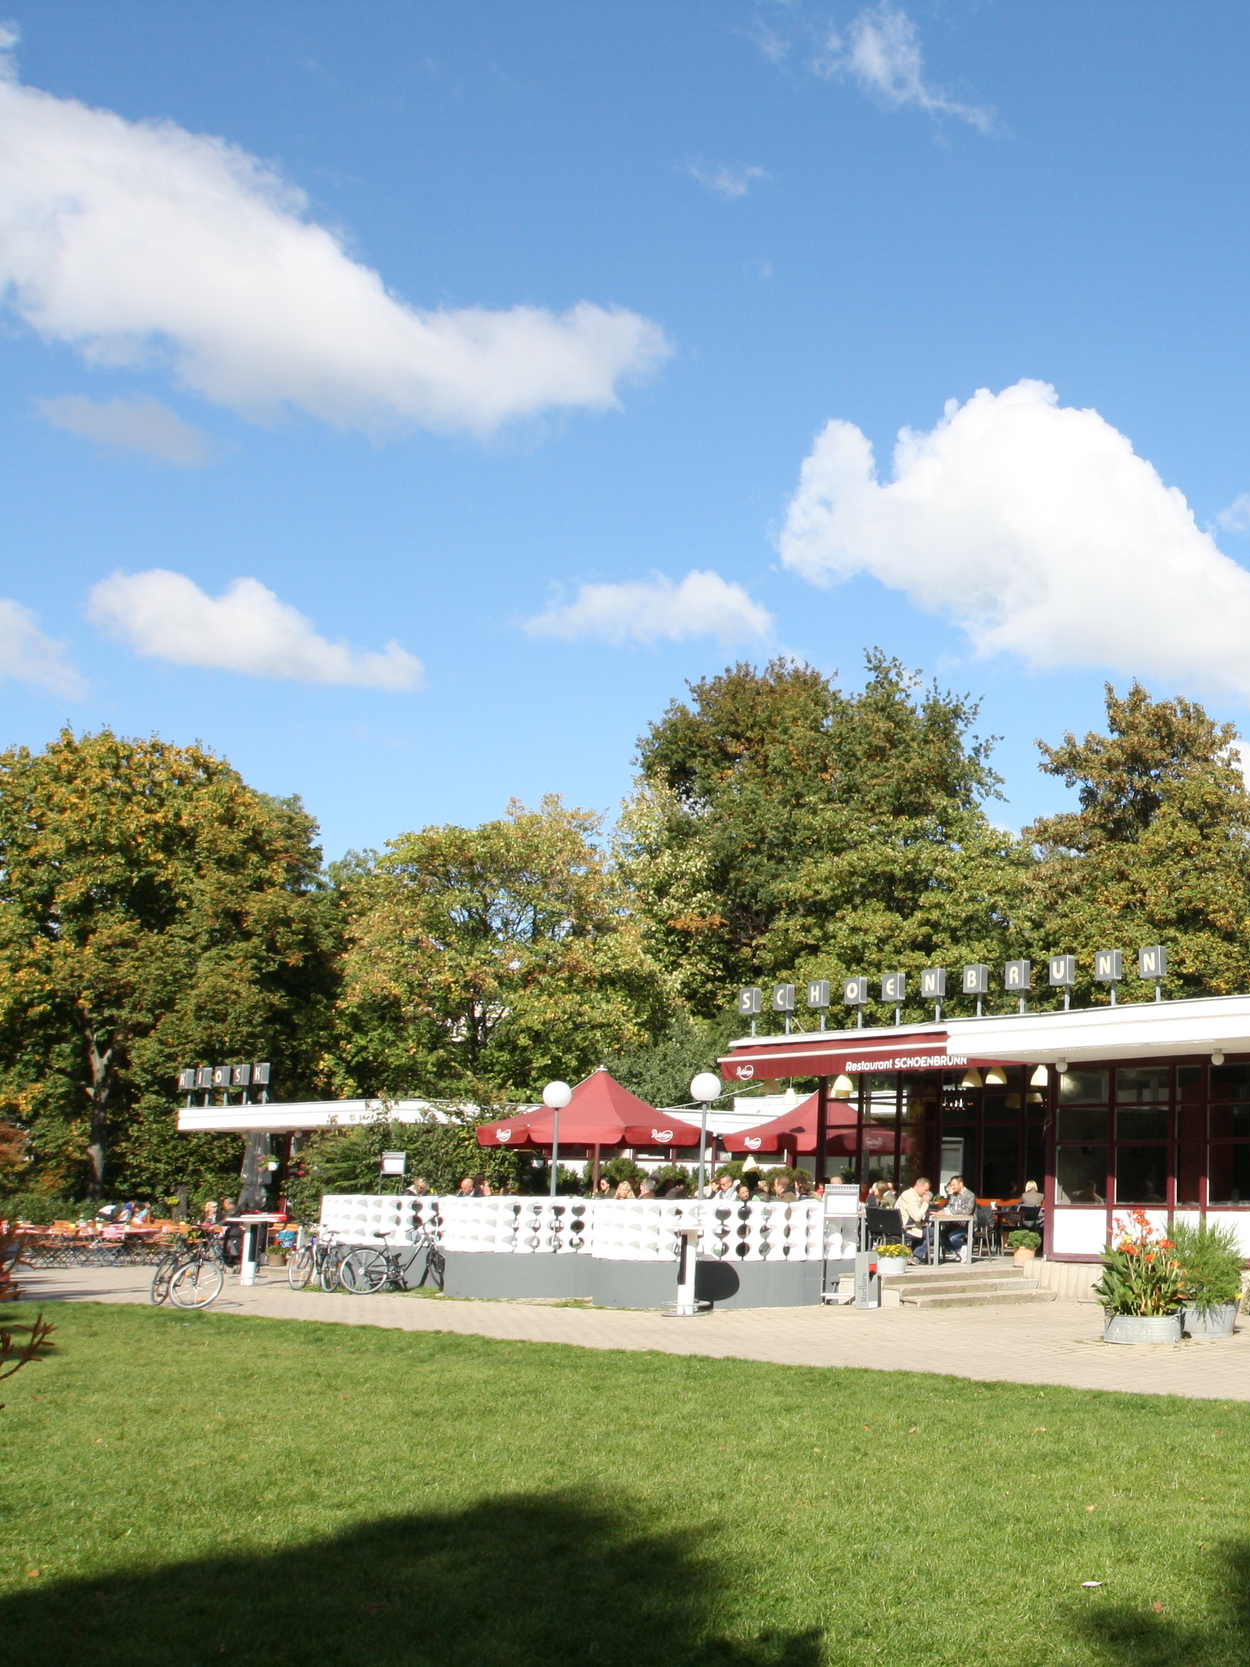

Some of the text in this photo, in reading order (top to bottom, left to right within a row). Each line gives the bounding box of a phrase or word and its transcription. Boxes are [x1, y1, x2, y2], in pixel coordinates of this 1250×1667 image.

[742, 951, 1156, 1008] SCHOENBRUNN
[845, 1055, 968, 1072] Restaurant SCHOENBRUNN
[179, 1066, 261, 1086] KIOSK
